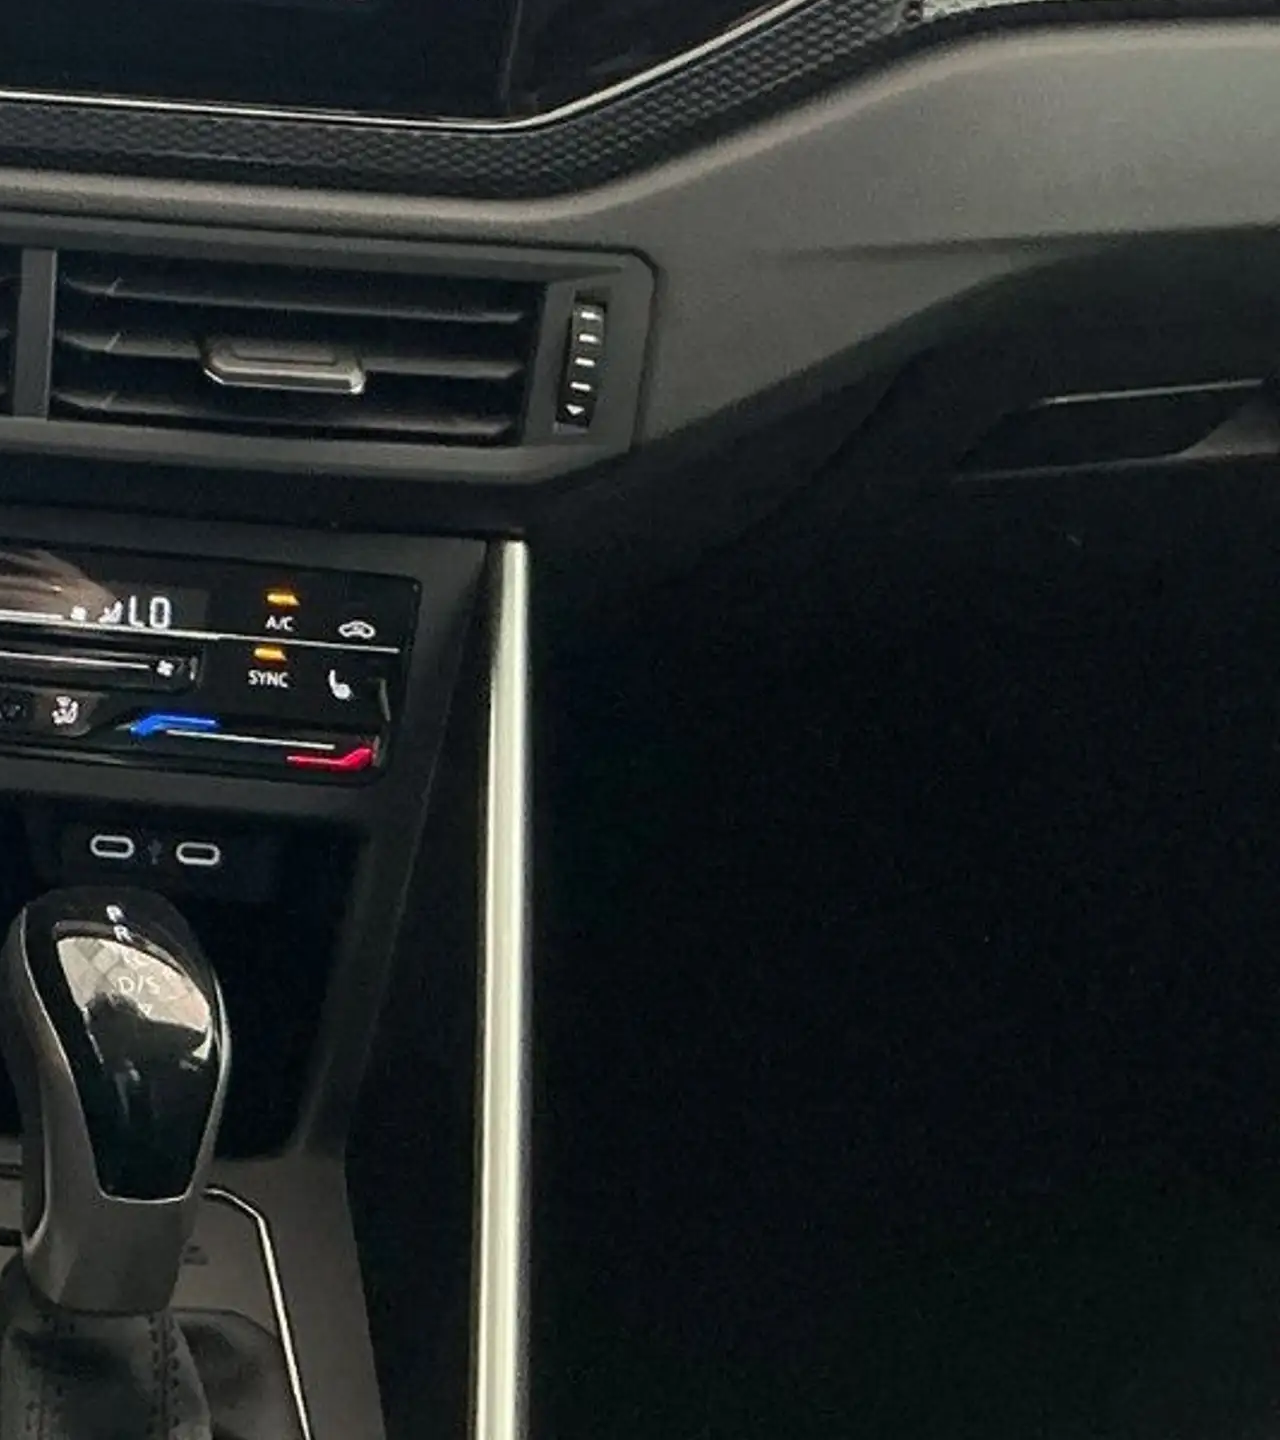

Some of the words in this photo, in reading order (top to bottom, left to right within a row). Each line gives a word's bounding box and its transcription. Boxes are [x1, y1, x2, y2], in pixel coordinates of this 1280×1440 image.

[128, 595, 172, 629] LO
[265, 615, 295, 633] A/C
[248, 669, 289, 689] SYNC
